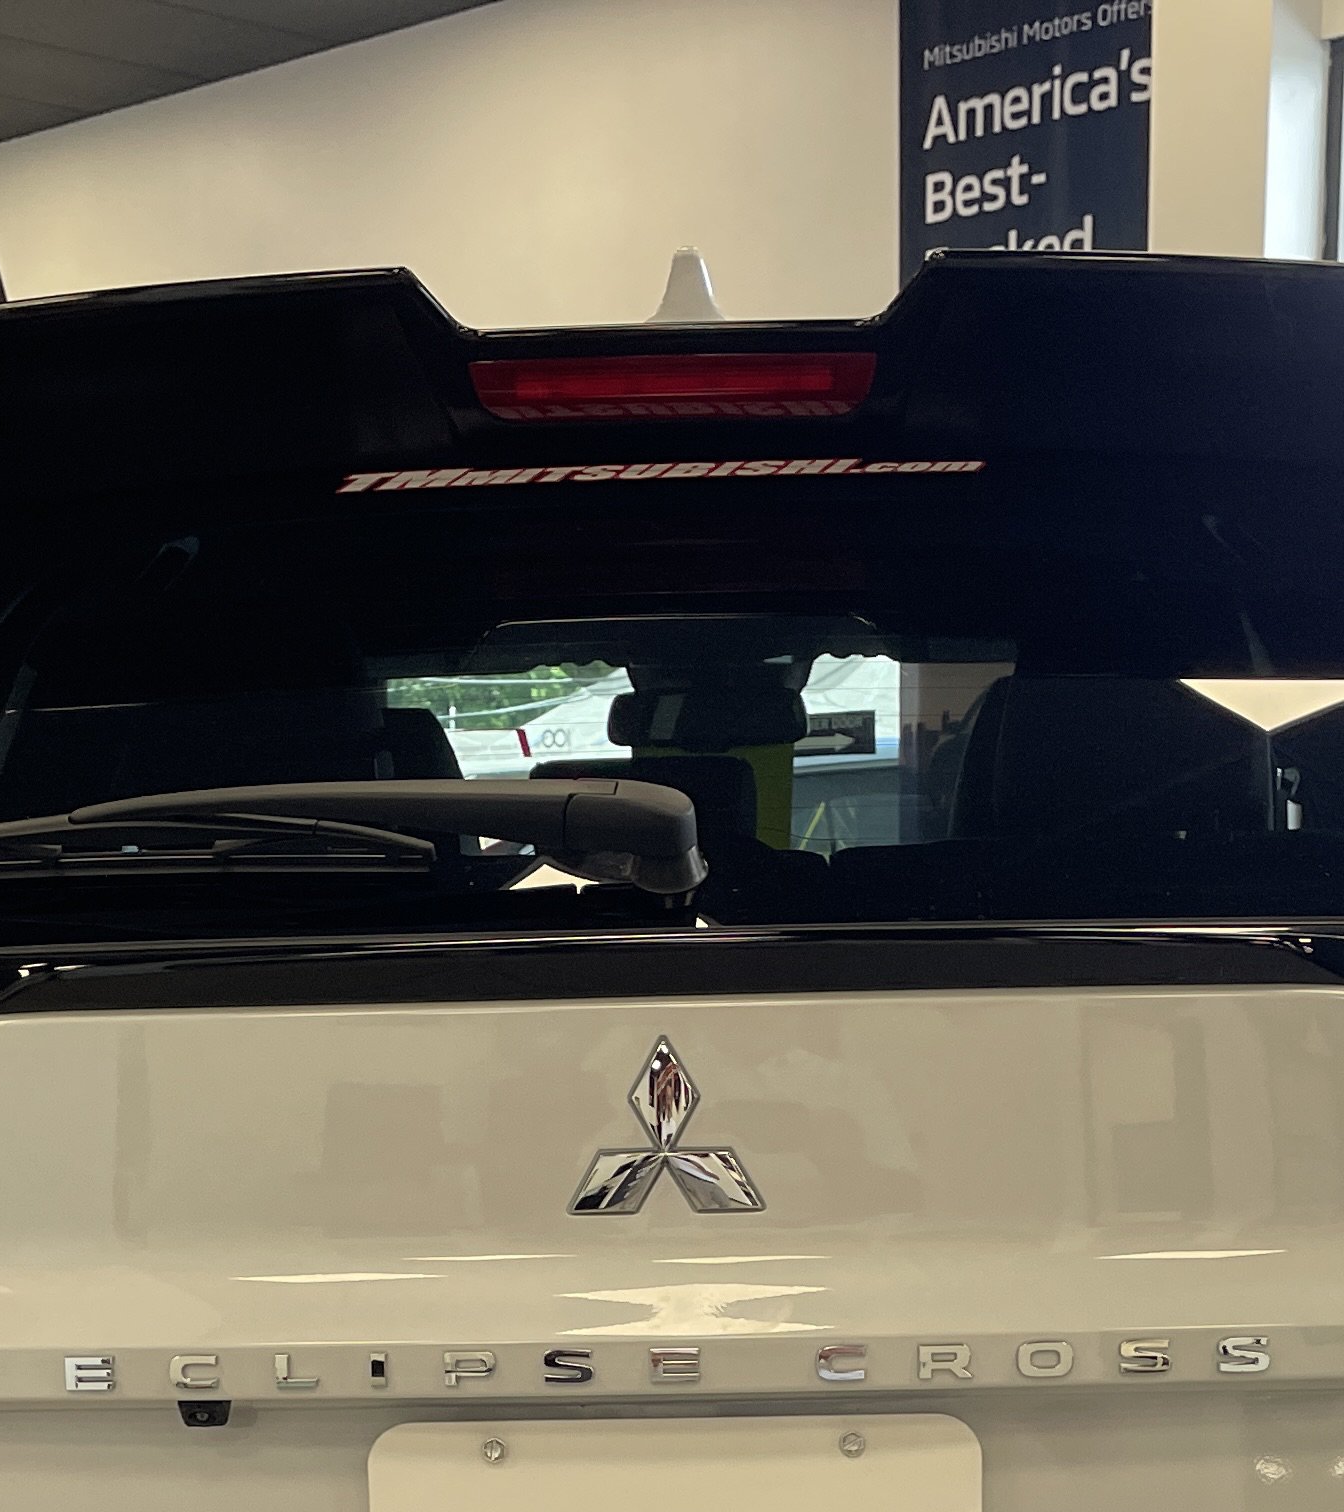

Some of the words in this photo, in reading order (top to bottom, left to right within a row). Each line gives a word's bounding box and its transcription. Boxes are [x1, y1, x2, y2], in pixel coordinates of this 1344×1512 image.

[923, 26, 1018, 70] Mitsubishi
[1023, 11, 1092, 44] Motors
[922, 47, 1152, 150] America's
[925, 154, 1047, 225] Best-
[64, 1346, 701, 1391] ECLIPSE
[816, 1335, 1270, 1383] CROSS
